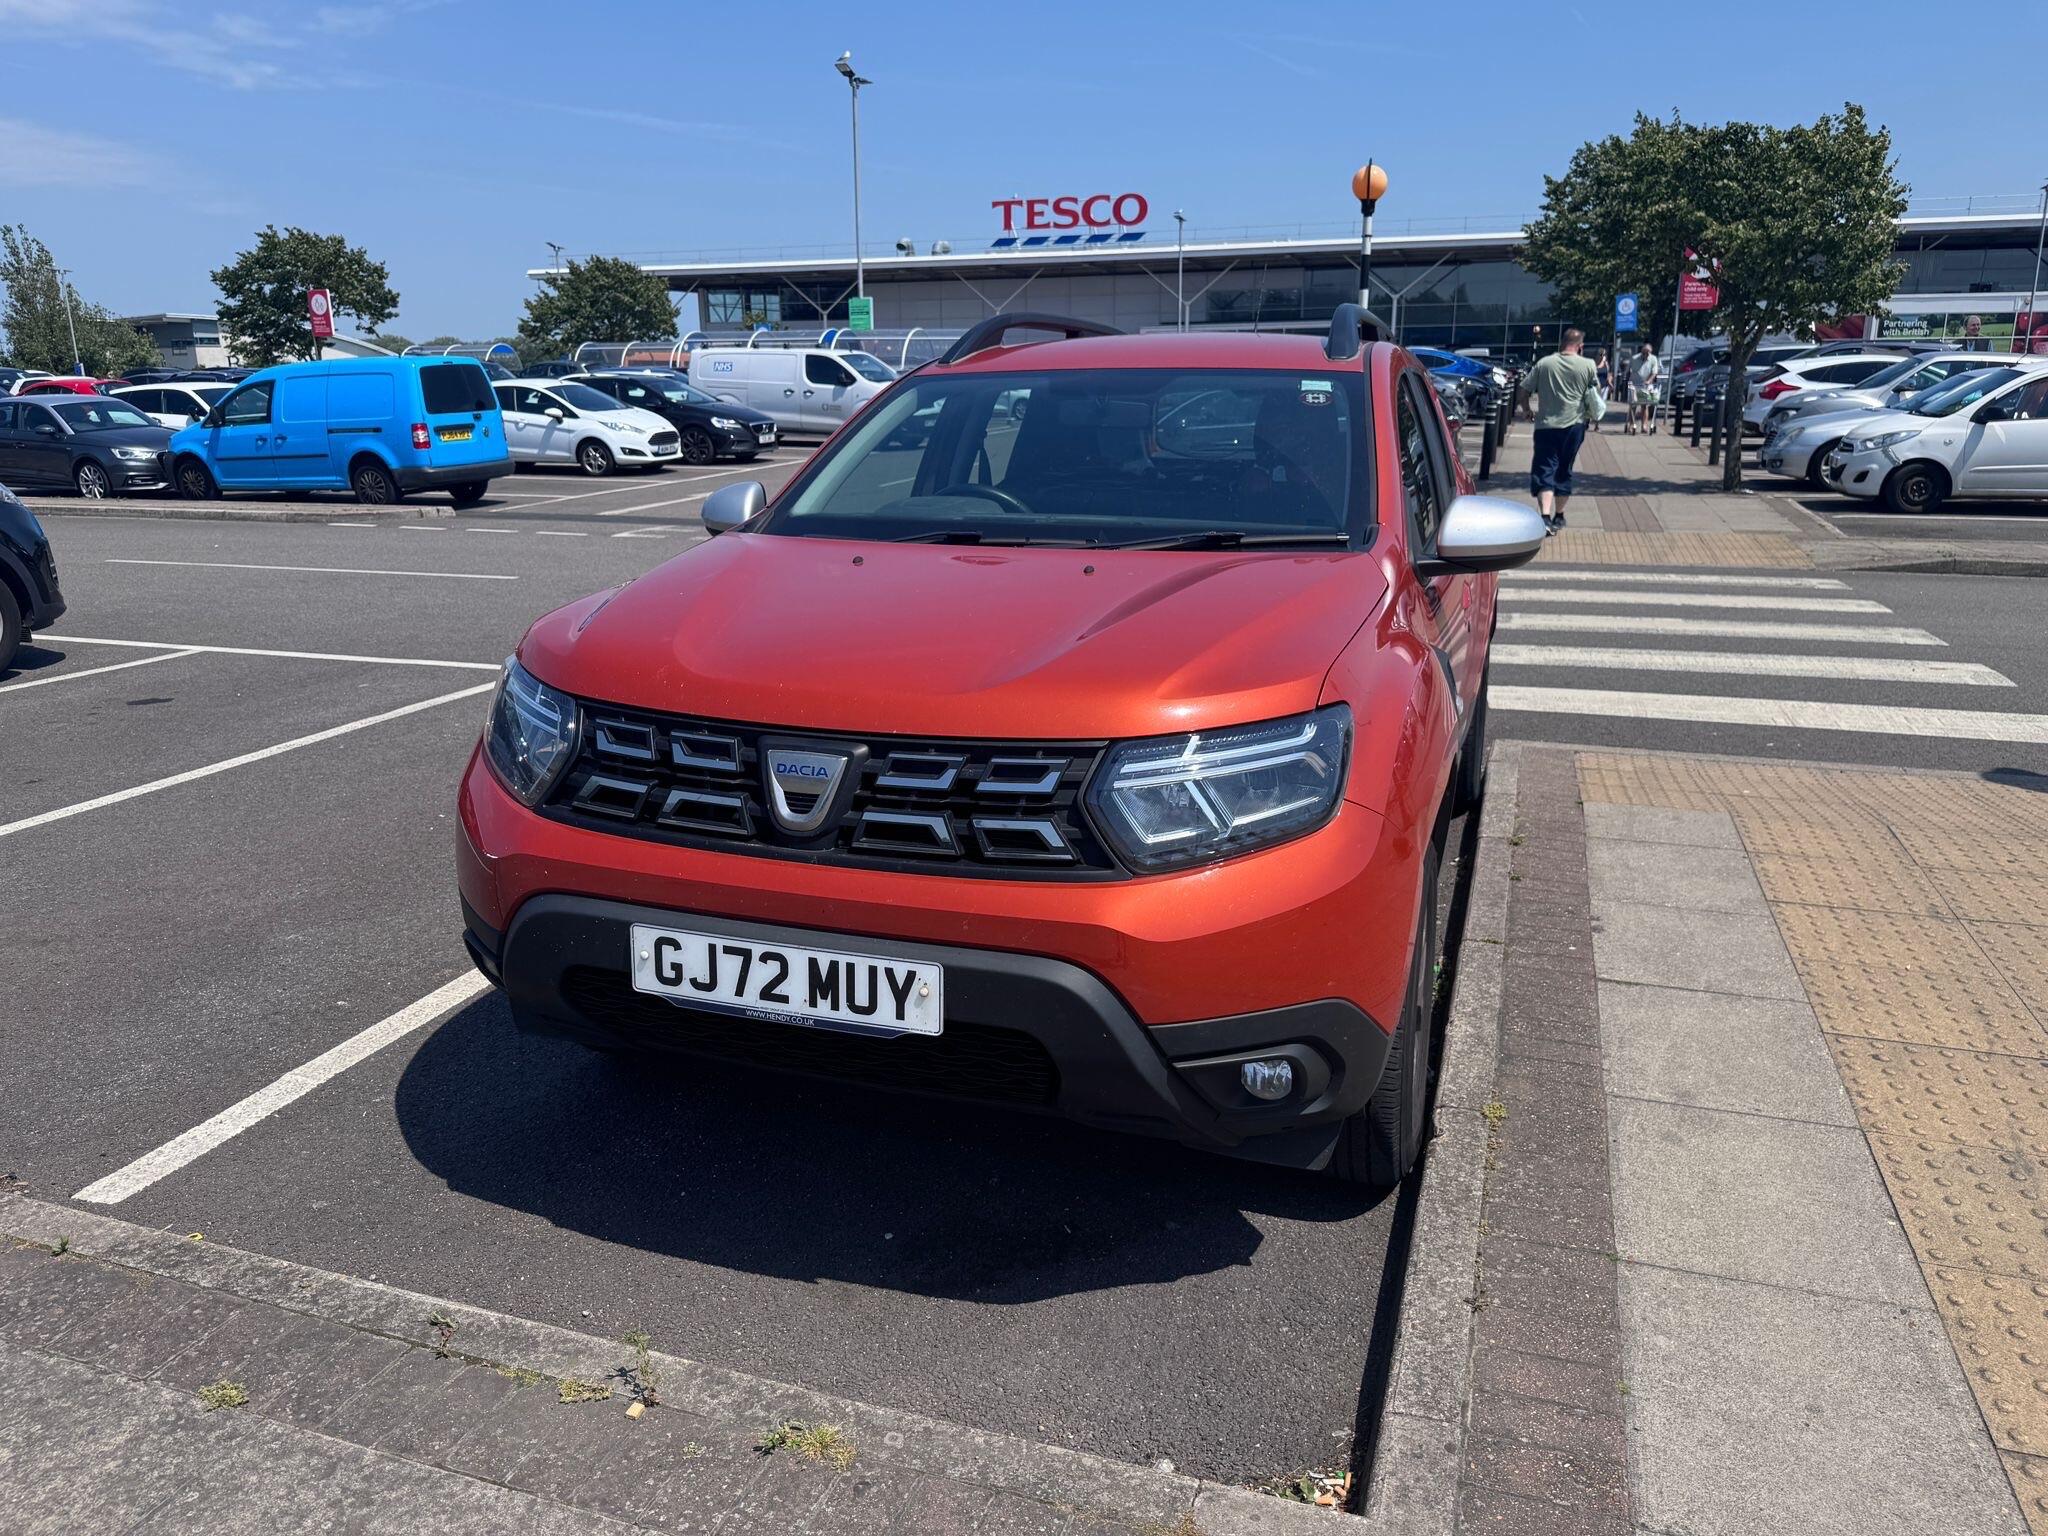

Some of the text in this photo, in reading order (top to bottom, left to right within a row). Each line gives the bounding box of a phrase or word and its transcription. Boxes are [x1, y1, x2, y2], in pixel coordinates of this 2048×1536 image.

[992, 193, 1148, 231] TESCO
[1883, 319, 1928, 329] Partnering
[1882, 328, 1930, 336] with British
[714, 362, 732, 372] NHS
[776, 763, 829, 778] DACIA
[653, 936, 917, 1021] GJ72 MUY
[745, 1009, 815, 1027] WWW.HENDY.CO.UK
